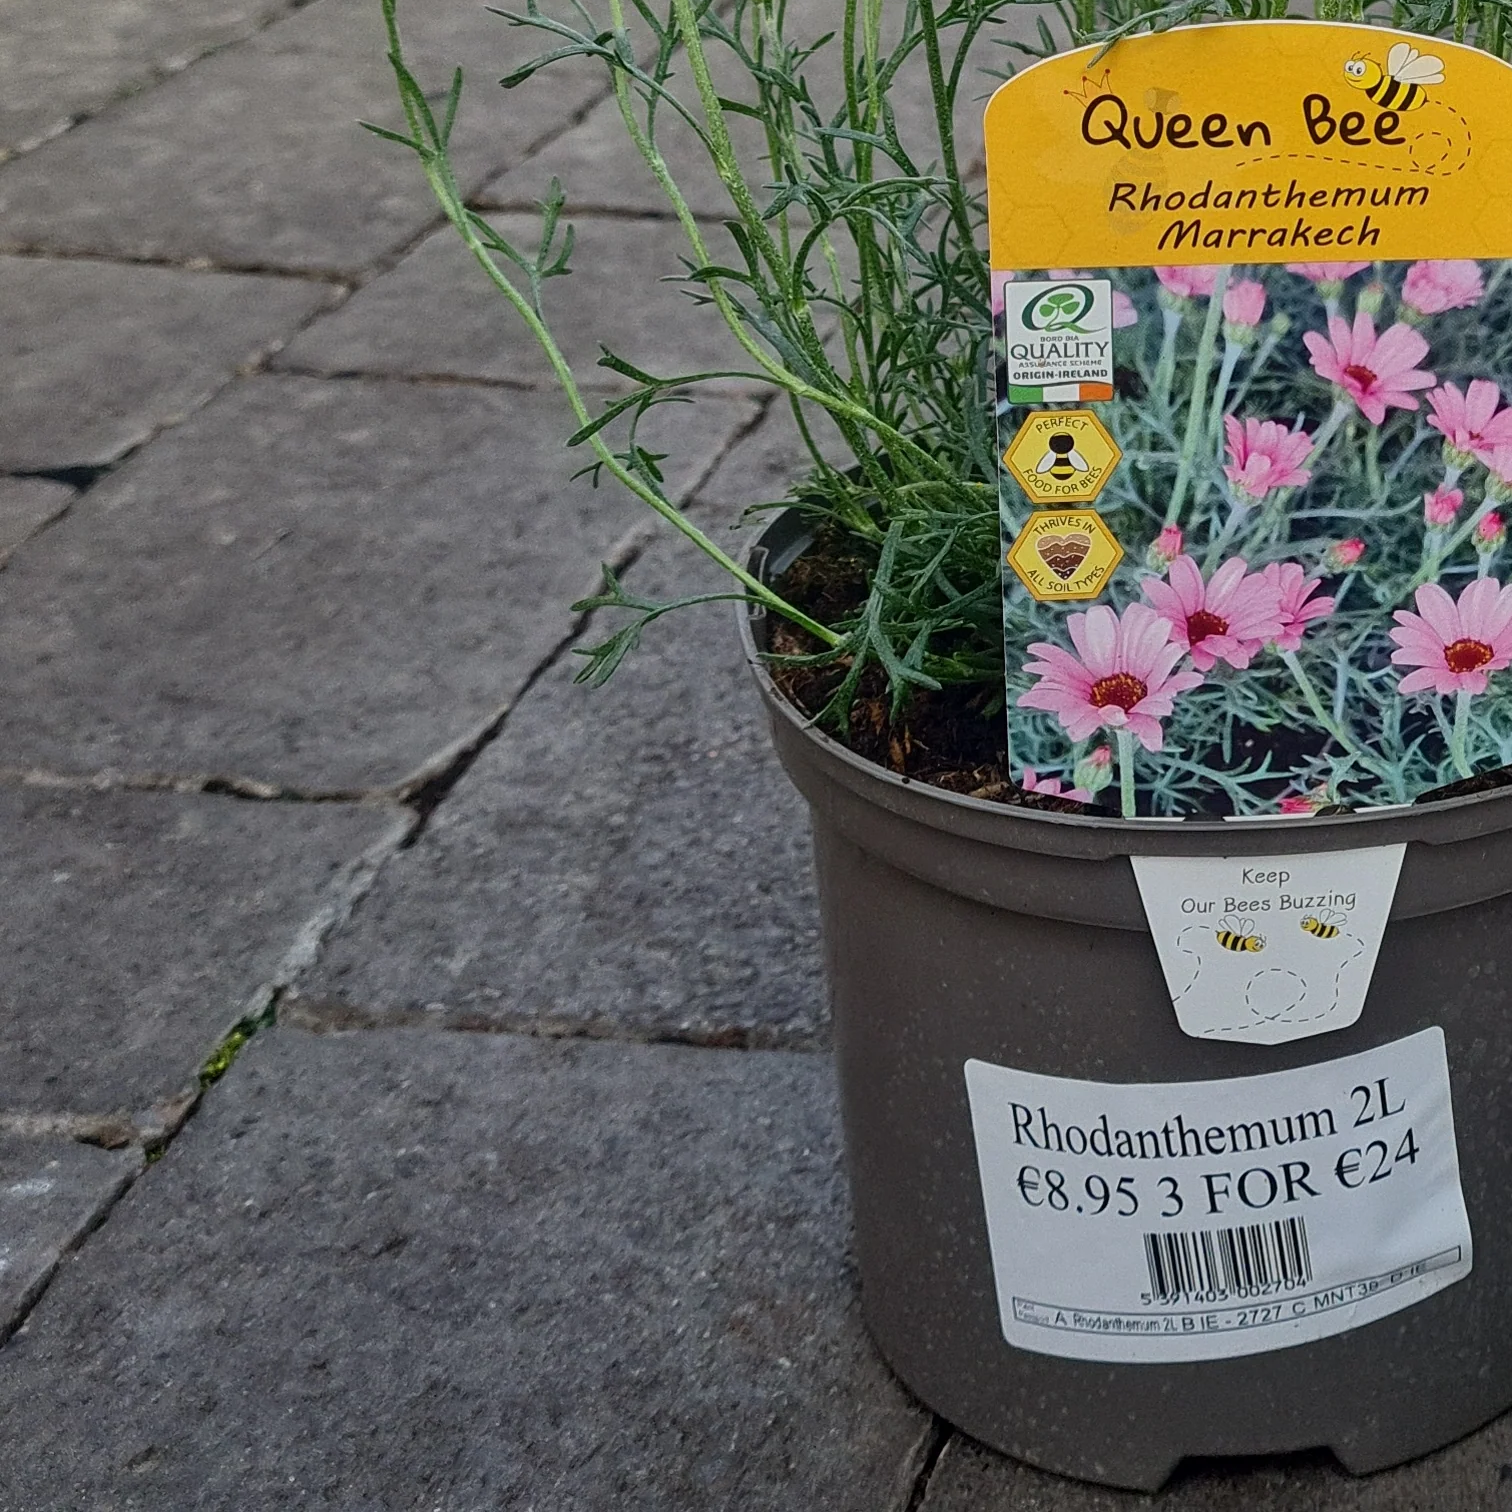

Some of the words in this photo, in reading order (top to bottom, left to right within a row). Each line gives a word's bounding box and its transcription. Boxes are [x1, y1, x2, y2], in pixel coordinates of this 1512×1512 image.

[1081, 93, 1272, 150] Queen
[1302, 93, 1406, 146] Bee
[1108, 179, 1430, 212] Rhodanthemum
[1157, 215, 1381, 250] Marrakech
[1010, 341, 1110, 361] QUALITY
[1013, 369, 1108, 380] ORIGIN-IRELAND
[1018, 360, 1068, 369] ASSUANCE
[1036, 416, 1089, 434] PERFECT
[1023, 468, 1053, 493] FOOD
[1055, 483, 1080, 495] FOR
[1079, 466, 1103, 489] BEES
[1033, 516, 1082, 536] THRIVES
[1082, 521, 1097, 535] IN
[1027, 569, 1046, 587] ALL
[1046, 581, 1074, 593] SOIL
[1074, 565, 1105, 591] TYPES
[1242, 868, 1291, 888] Keep
[1181, 897, 1216, 914] Our
[1224, 895, 1271, 913] Bees
[1279, 890, 1357, 911] Buzzing
[1008, 1102, 1338, 1160] Rhodanthemum
[1350, 1077, 1407, 1129] 2L
[1017, 1165, 1140, 1217] €8.95
[1157, 1176, 1184, 1218] 3
[1200, 1161, 1323, 1215] FOR
[1334, 1127, 1420, 1189] €24
[1140, 1292, 1152, 1306] 5
[1055, 1310, 1068, 1326] A
[1181, 1316, 1195, 1331] B
[1201, 1314, 1220, 1330] IE
[1237, 1304, 1283, 1326] 2727
[1292, 1301, 1305, 1315] C
